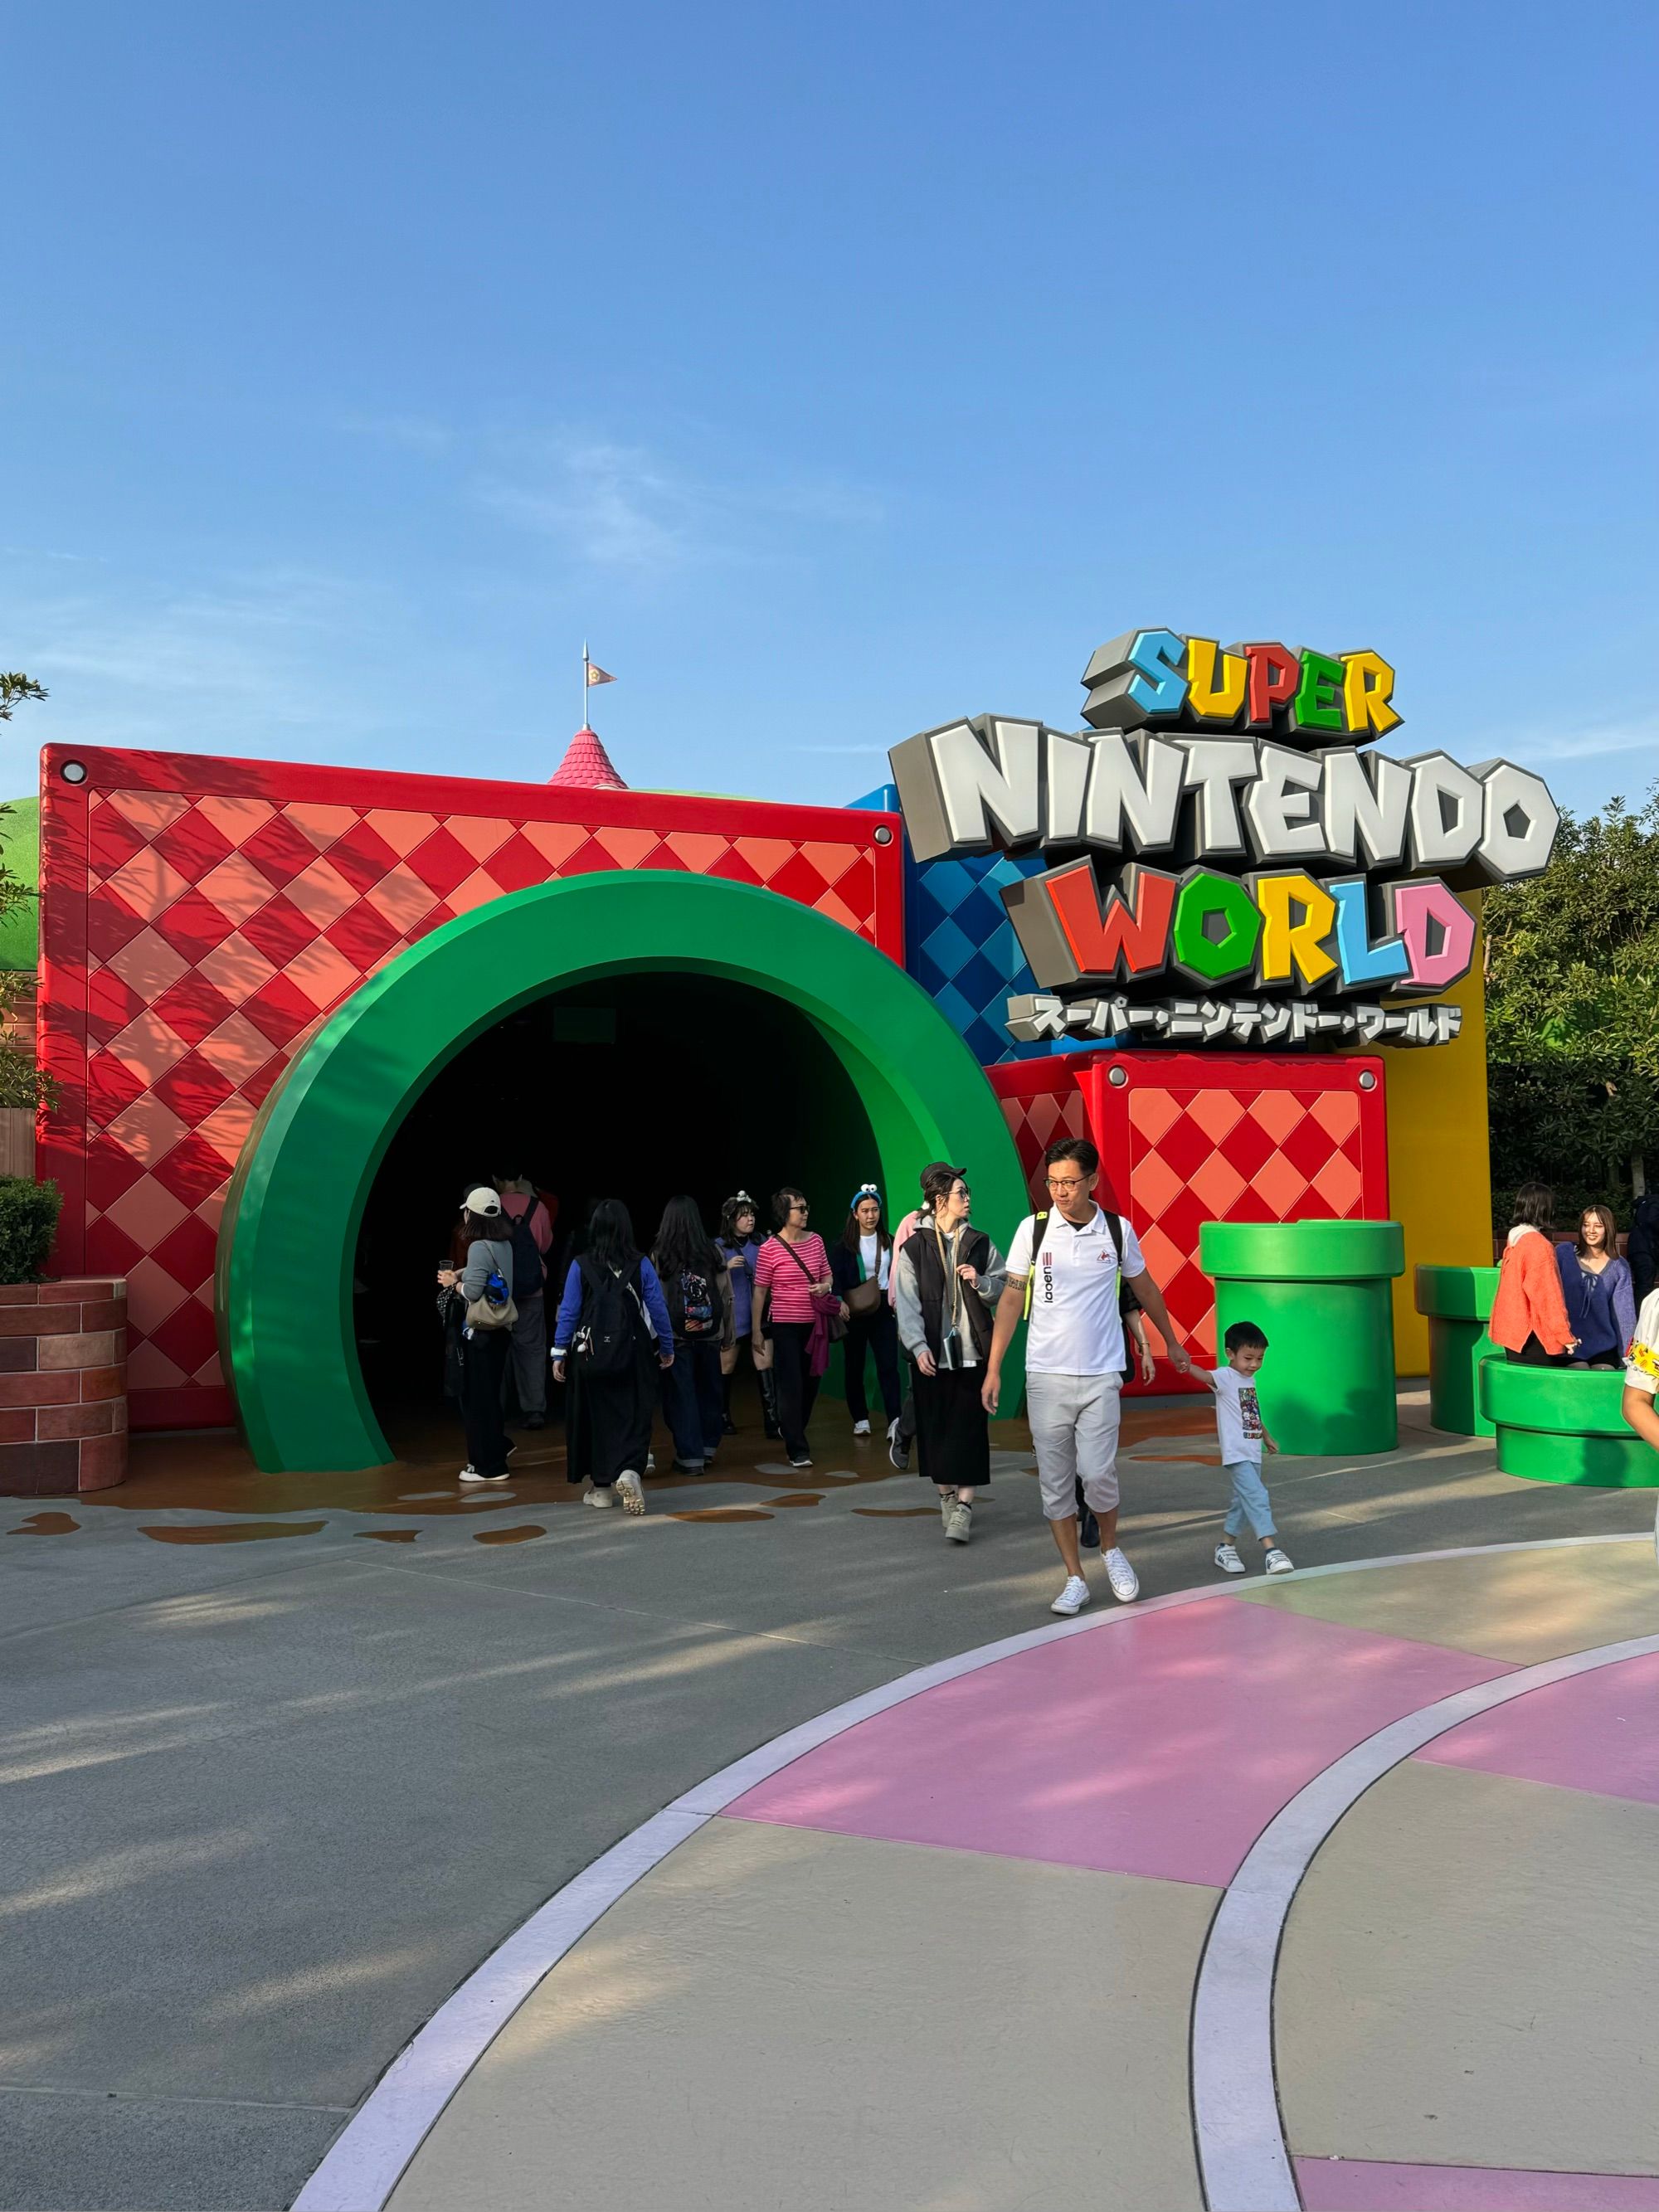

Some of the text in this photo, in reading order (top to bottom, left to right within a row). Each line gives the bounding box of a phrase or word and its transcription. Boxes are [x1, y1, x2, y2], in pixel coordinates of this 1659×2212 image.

[1126, 627, 1395, 732] SUPER
[929, 716, 1561, 875] NINTENDO
[1044, 863, 1477, 986] WORLD
